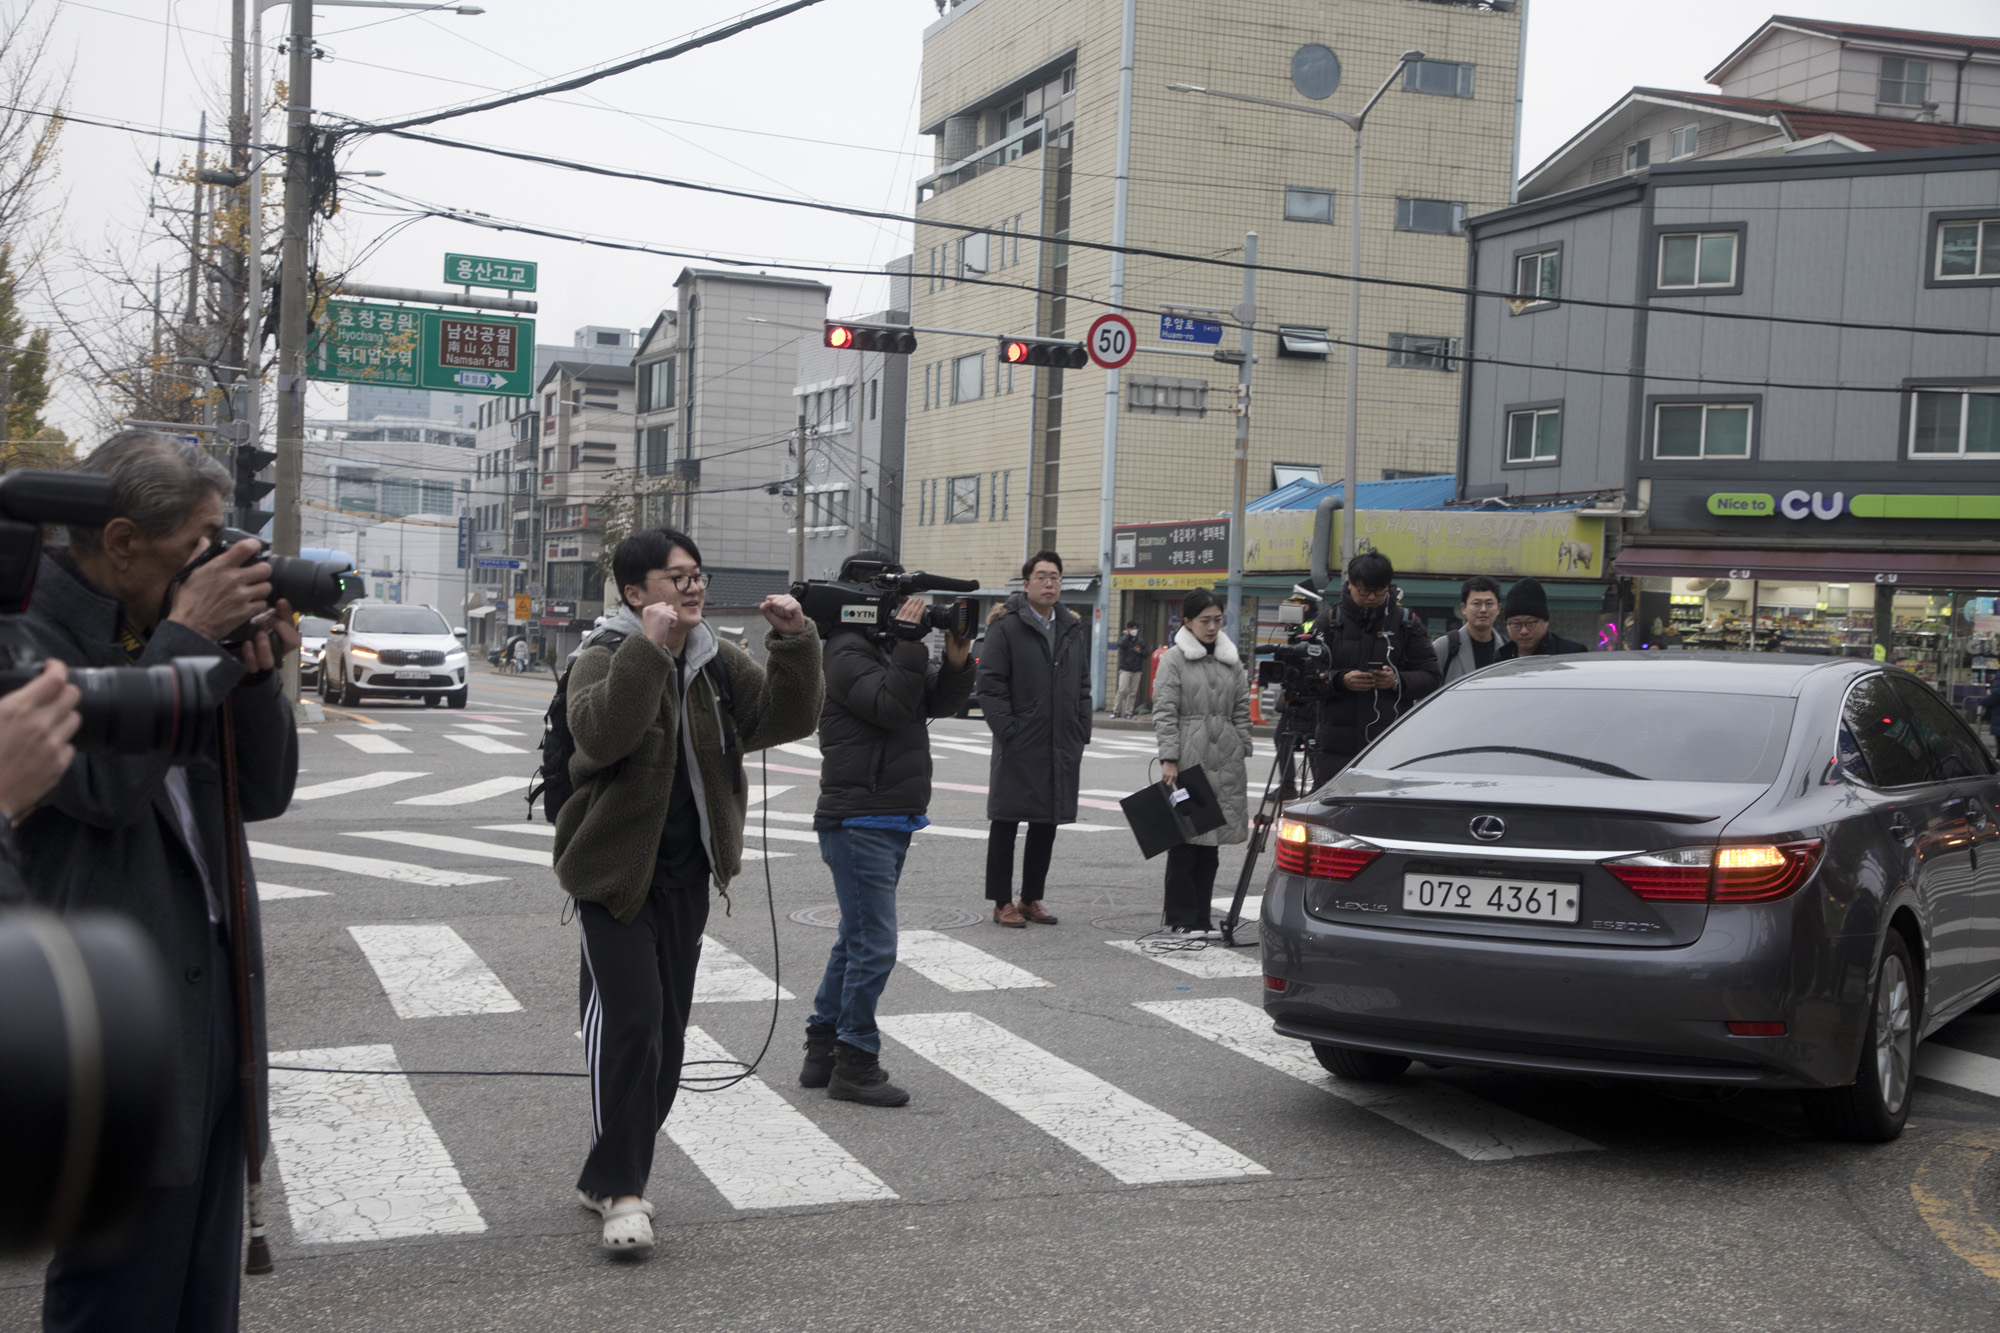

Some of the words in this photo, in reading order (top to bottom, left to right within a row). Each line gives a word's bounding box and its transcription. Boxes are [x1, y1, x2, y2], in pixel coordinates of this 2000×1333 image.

[456, 259, 526, 284] 용산고교
[339, 308, 413, 332] 효창공원
[1163, 316, 1195, 331] 후암로
[338, 328, 383, 345] Hyochang
[447, 323, 511, 344] 남산공원
[1099, 329, 1125, 354] 50
[1161, 331, 1195, 341] Huam-ro
[446, 353, 485, 366] Namsan
[488, 356, 509, 368] Park
[464, 374, 486, 384] 후암로
[1717, 498, 1749, 510] Nice
[1752, 499, 1766, 510] to
[1781, 489, 1844, 520] CU
[1364, 516, 1464, 536] CHANG
[1480, 518, 1570, 538] SURIN
[856, 610, 875, 618] YTN
[1419, 880, 1472, 908] 07오
[1486, 885, 1558, 915] 4361
[1335, 900, 1388, 913] LEXUS
[1592, 920, 1661, 933] ES300h
